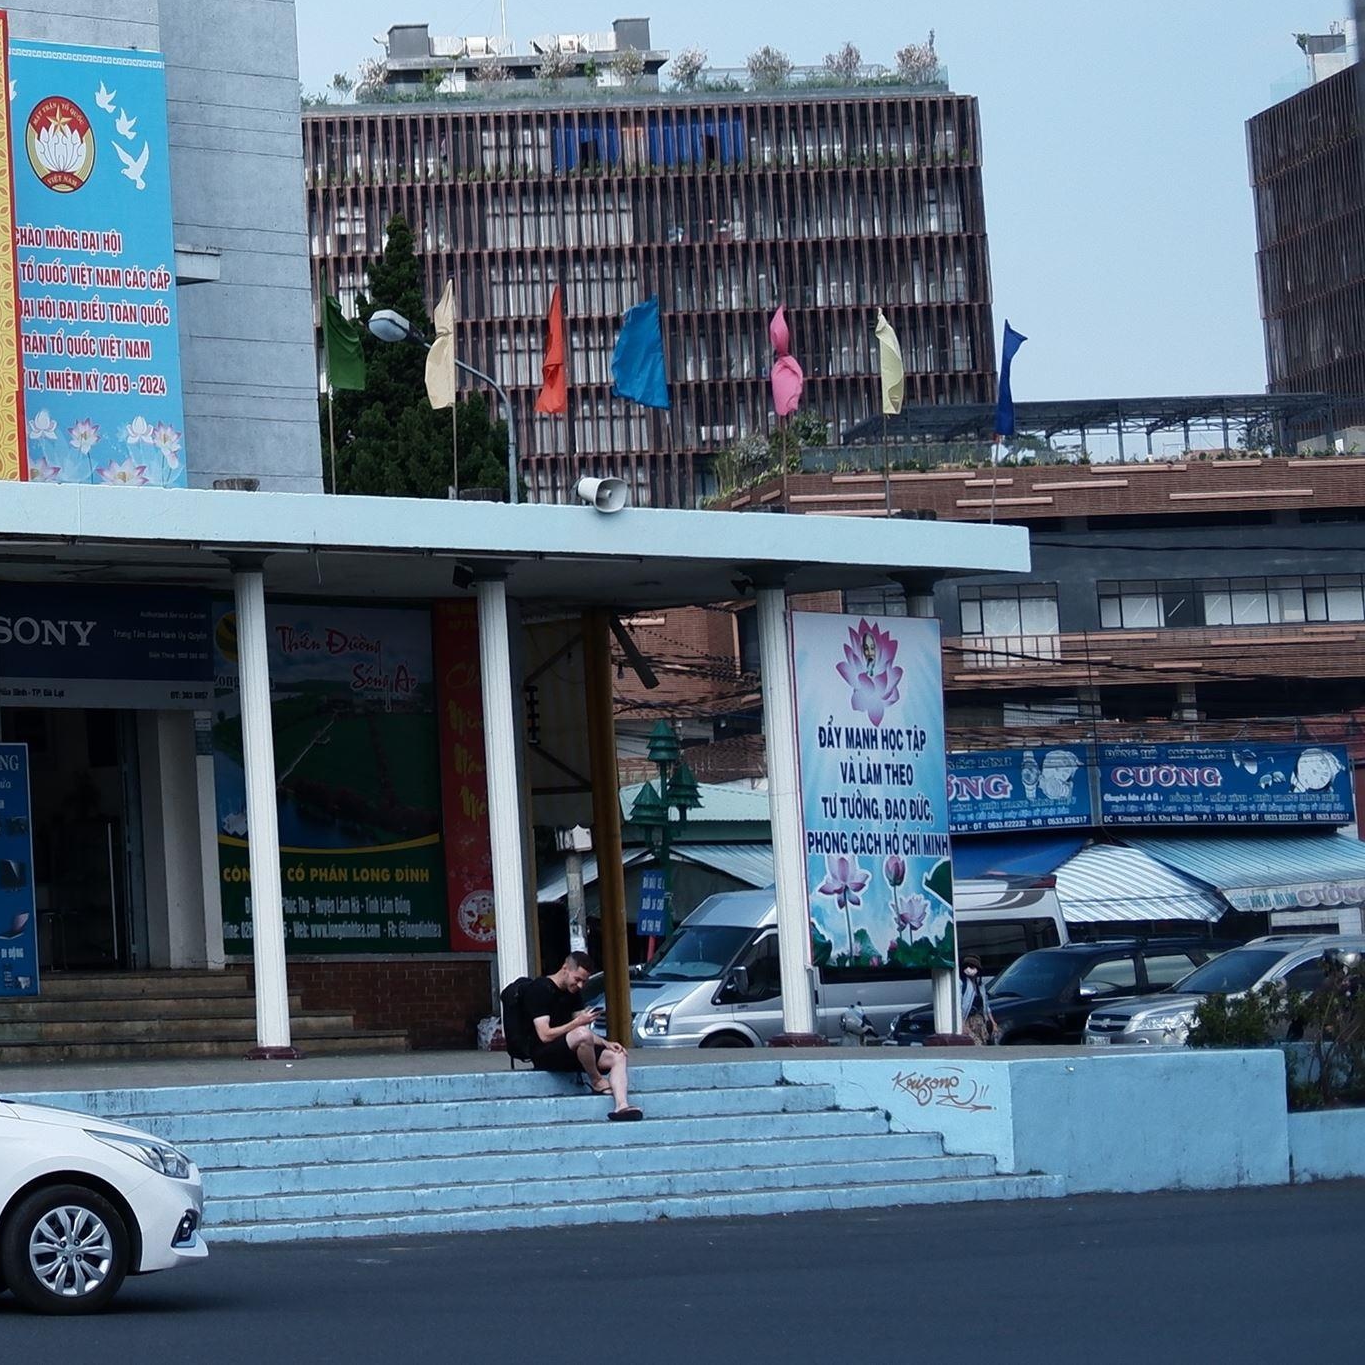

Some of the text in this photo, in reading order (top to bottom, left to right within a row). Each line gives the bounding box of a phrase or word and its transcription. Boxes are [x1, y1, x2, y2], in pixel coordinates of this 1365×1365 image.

[46, 225, 78, 249] MỪNG
[82, 232, 100, 254] ĐẠI
[103, 229, 121, 257] HỘI
[21, 256, 171, 290] TỔ QUỐC VIỆT NAM CÁC CẤP
[38, 295, 169, 325] HỘI ĐẠI BIỂU TOÀN QUỐC
[50, 328, 63, 354] TỔ
[67, 331, 96, 356] QUỐC
[99, 335, 121, 361] VIỆT
[125, 340, 150, 358] NAM
[28, 367, 165, 395] IX, NHIỆM KỲ 2019 2024
[276, 625, 321, 653] Thiên
[818, 715, 926, 758] ĐẨY MẠNH HỌC TẬP
[840, 756, 914, 786] VÀ LÀM THEO
[1111, 765, 1223, 787] CƯỜNG
[821, 793, 837, 819] TƯ
[840, 789, 882, 825] TƯỞNG,
[885, 799, 906, 825] ĐẠO
[910, 793, 934, 826] ĐỨC,
[807, 823, 949, 856] PHONG CÁCH HỒ CHÍ MINH
[310, 863, 348, 883] PHẦN
[352, 867, 391, 882] LONG
[395, 864, 430, 883] ĐỈNH
